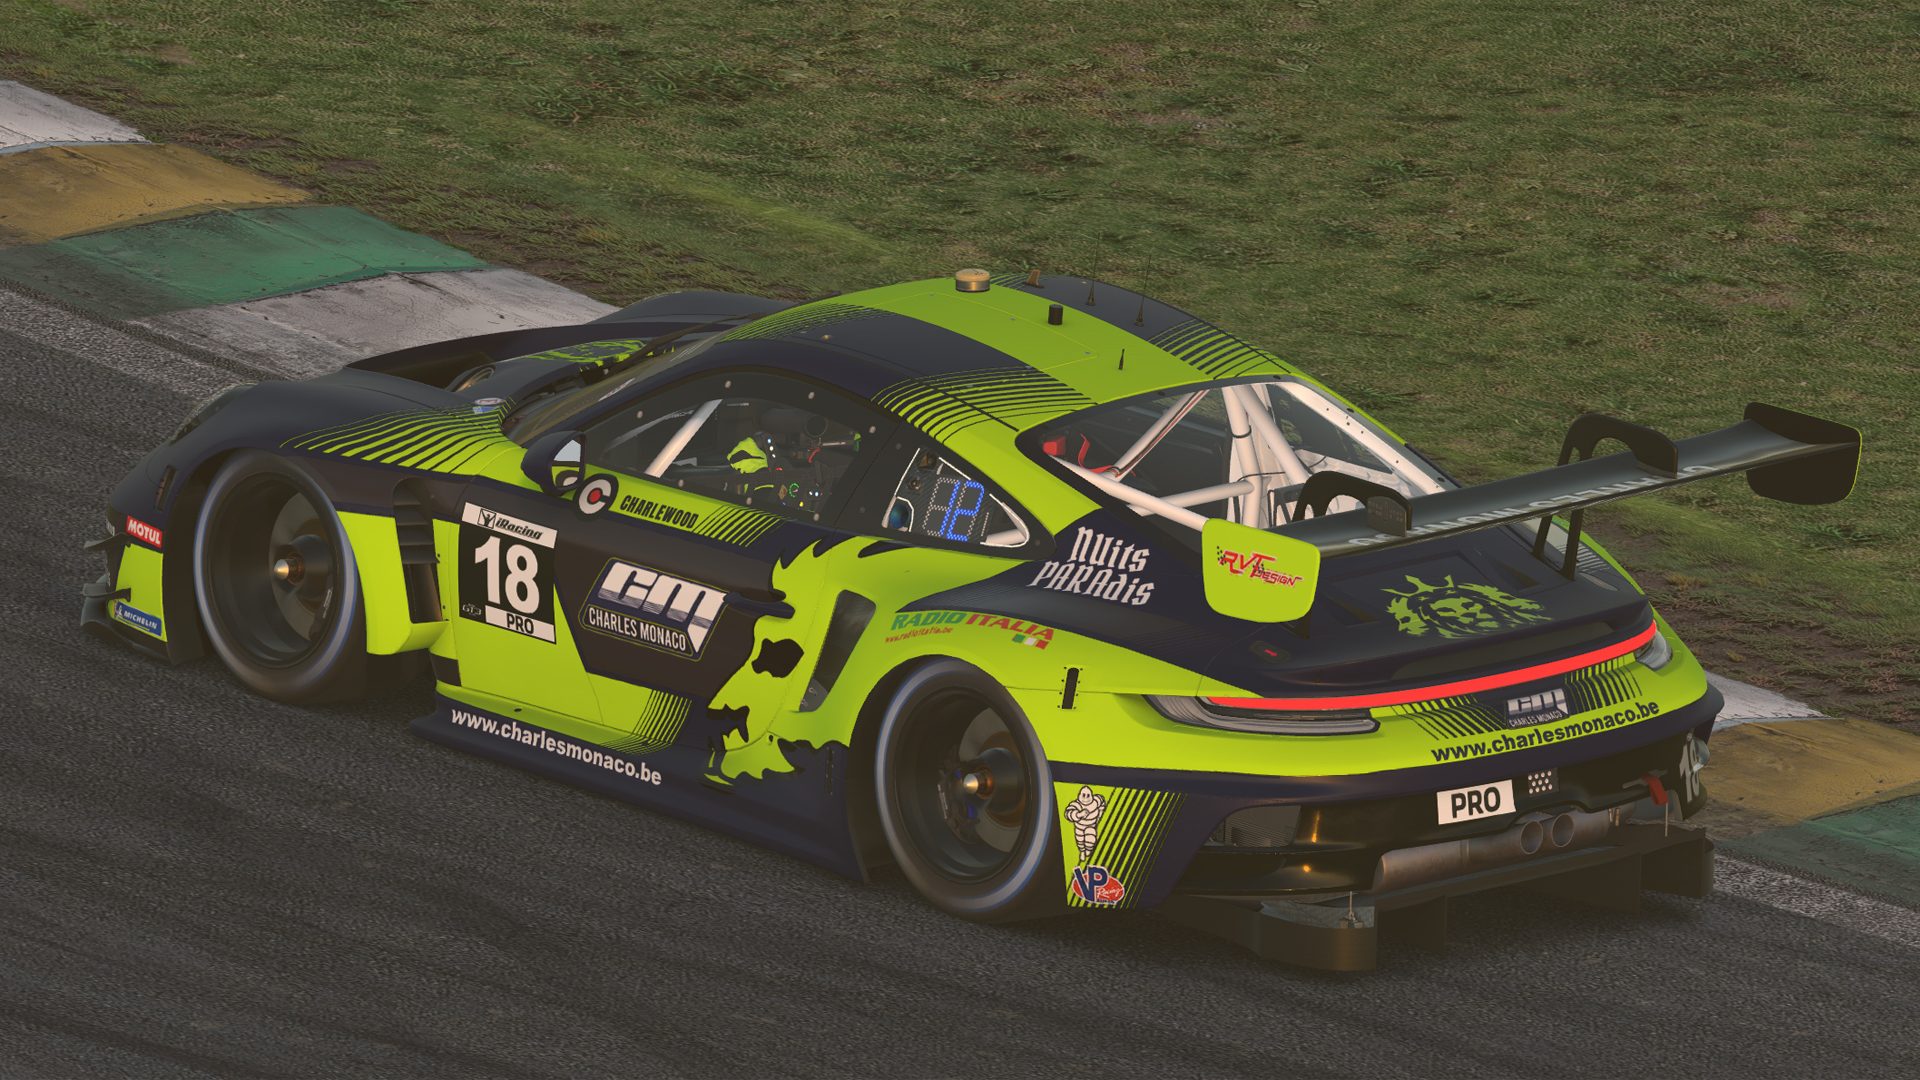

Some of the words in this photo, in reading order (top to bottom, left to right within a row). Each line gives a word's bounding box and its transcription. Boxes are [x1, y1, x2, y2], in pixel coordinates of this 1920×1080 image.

[620, 495, 699, 528] CHARLEWOOD
[940, 480, 984, 541] 12
[127, 519, 161, 545] MOTUL
[495, 517, 543, 540] iRacing
[475, 535, 540, 614] 18
[1219, 550, 1276, 578] RVT
[1254, 569, 1302, 587] DESIGN
[124, 610, 158, 630] MICHELIN
[506, 613, 534, 634] PRO
[588, 607, 638, 637] CHARLES
[640, 622, 687, 652] MONACO
[891, 611, 968, 631] RADIO
[965, 613, 1055, 641] ITALIA
[1431, 699, 1660, 762] www.charlesmonaco.be
[1509, 715, 1538, 728] CHARLES
[1536, 710, 1562, 723] MONACO
[451, 708, 662, 786] www.charlesmonaco.be
[1451, 787, 1501, 818] PRO
[1073, 865, 1108, 903] VP
